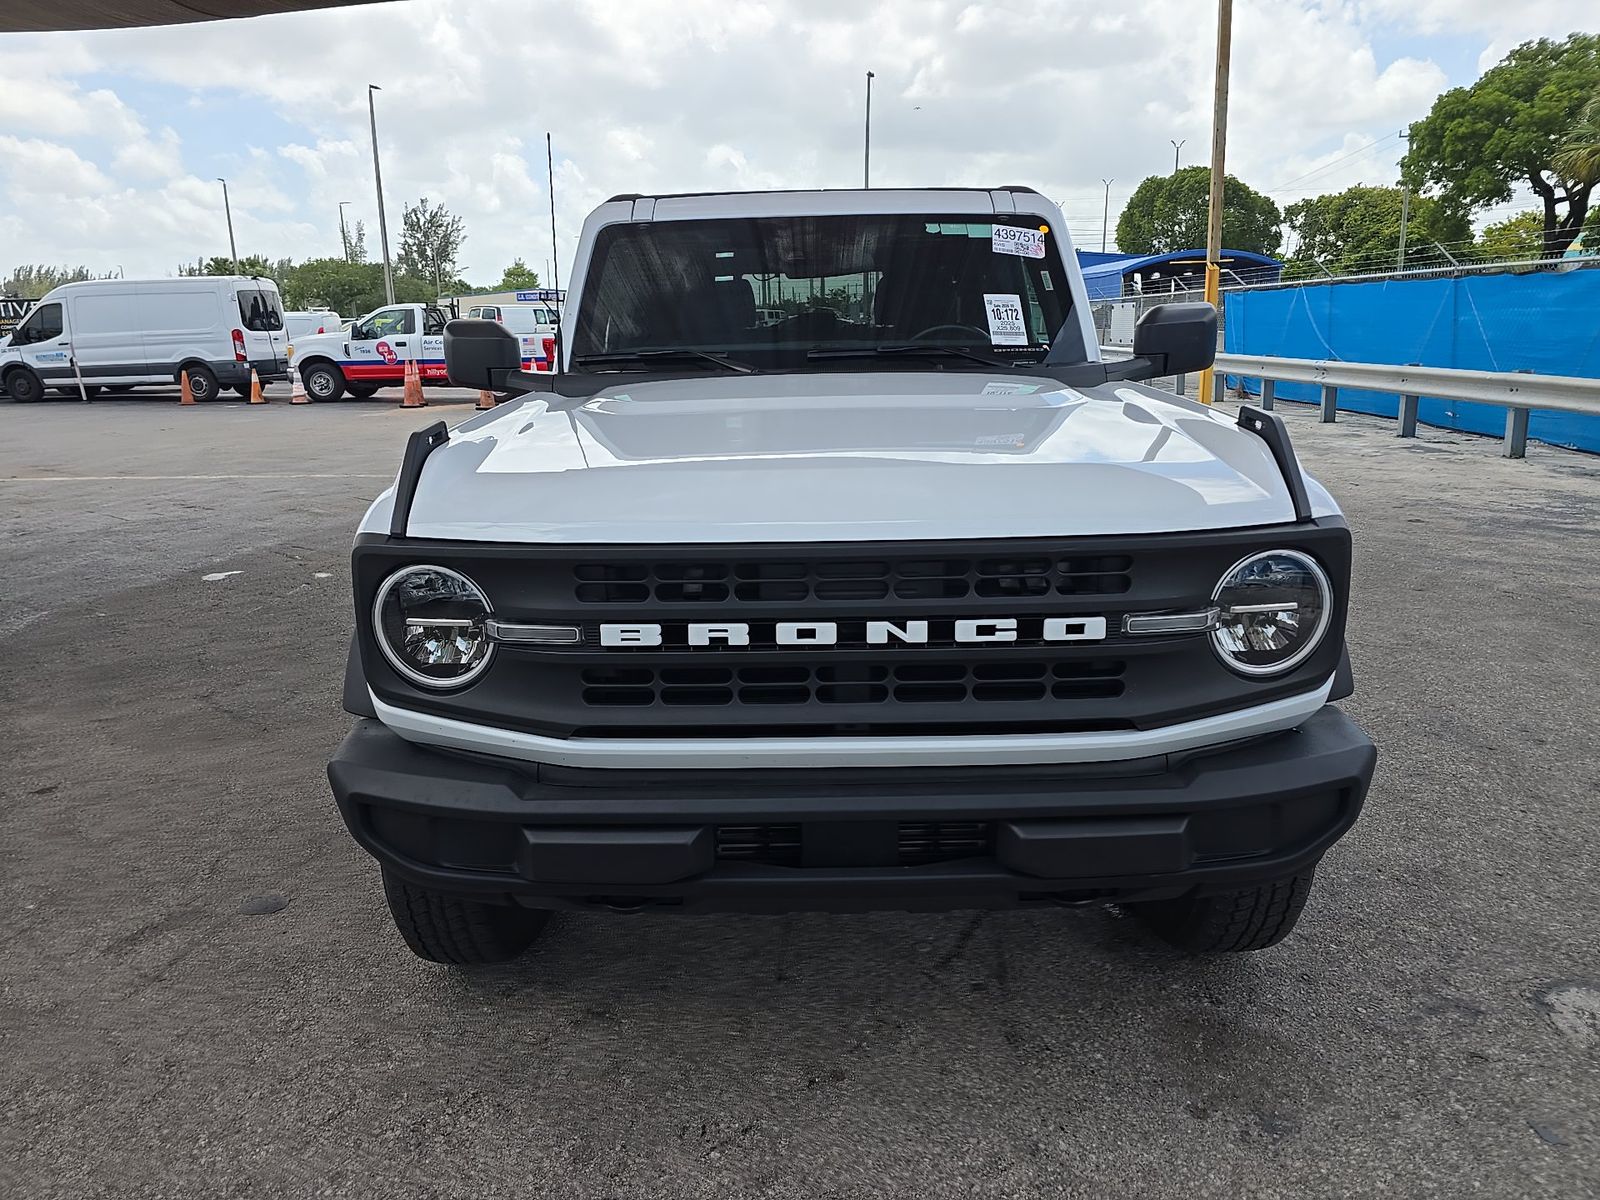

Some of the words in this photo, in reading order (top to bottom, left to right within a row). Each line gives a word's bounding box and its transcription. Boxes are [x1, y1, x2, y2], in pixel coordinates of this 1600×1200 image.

[994, 228, 1045, 244] 4397514
[991, 308, 1020, 321] 10:172
[426, 368, 447, 376] hillyo
[600, 616, 1107, 646] BRONCO
